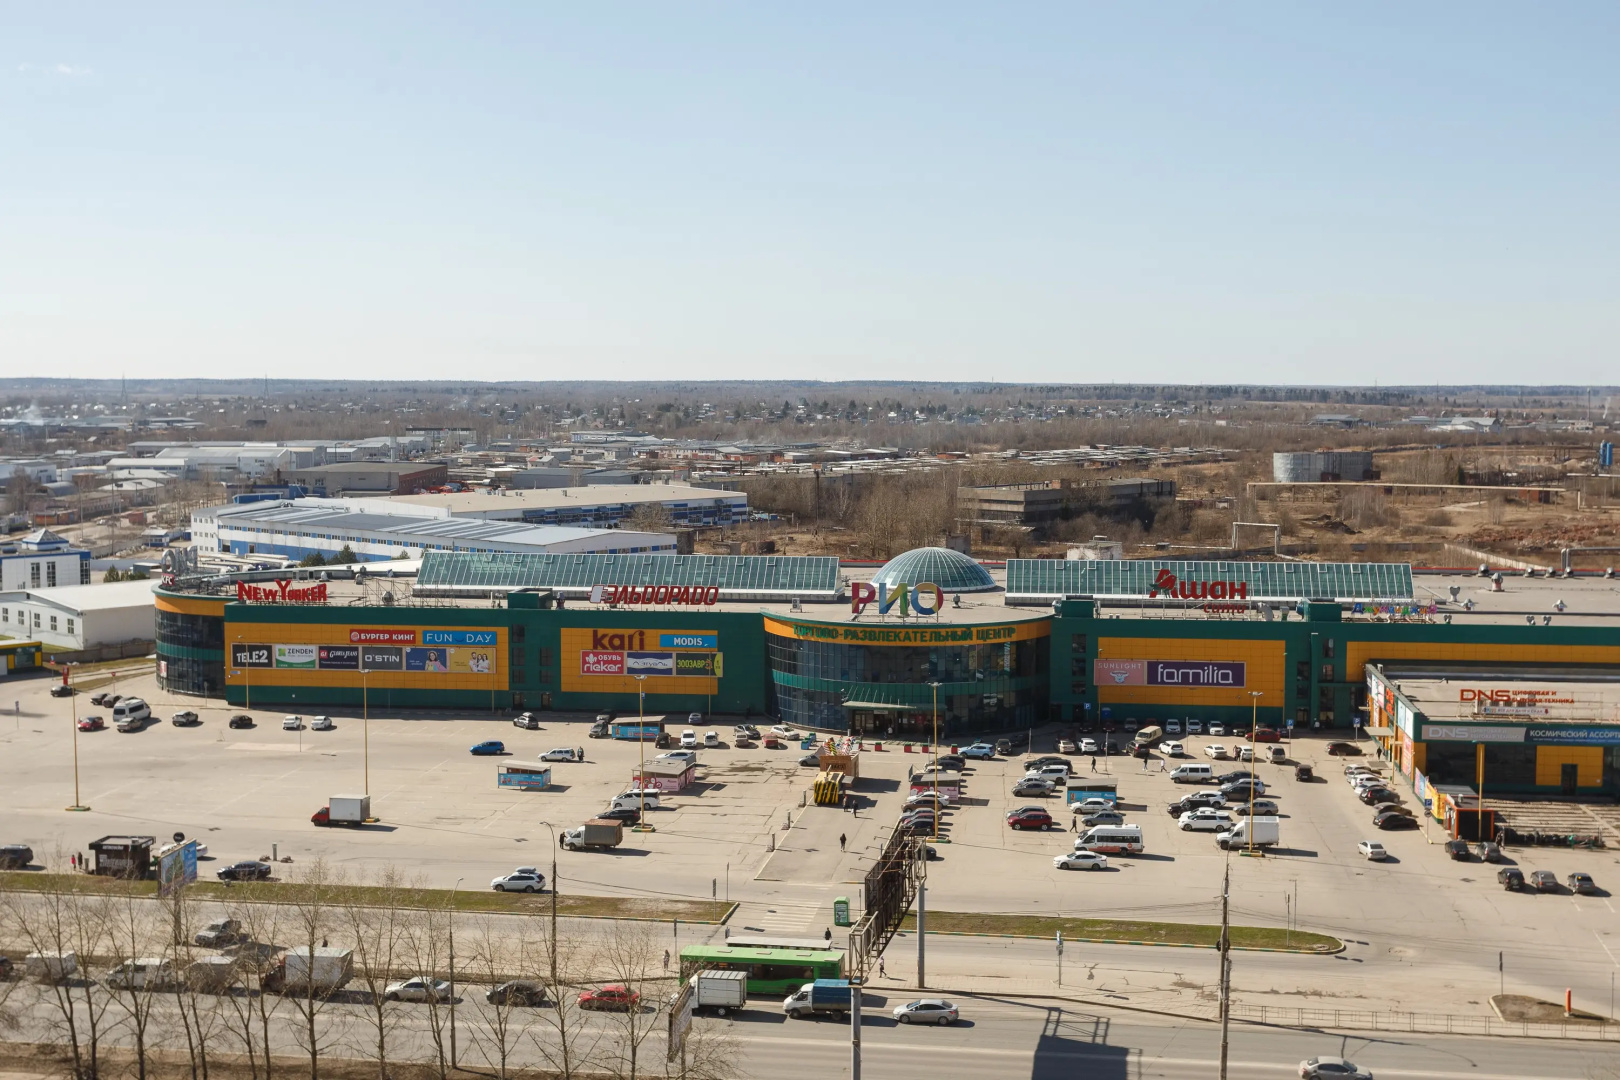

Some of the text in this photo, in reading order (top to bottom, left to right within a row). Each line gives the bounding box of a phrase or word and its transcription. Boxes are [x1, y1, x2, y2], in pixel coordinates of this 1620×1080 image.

[161, 574, 173, 585] KFC
[1149, 569, 1247, 600] Ашан
[851, 581, 944, 616] РИО
[392, 633, 415, 641] КИНГ
[426, 633, 492, 643] FUN DAY
[592, 629, 645, 651] kari
[976, 627, 1016, 642] ЦЕНТР
[673, 637, 703, 646] MODIS
[236, 650, 269, 663] TELE2
[583, 661, 622, 672] rieker
[1097, 662, 1142, 670] SUNLIGHT
[1157, 664, 1234, 684] familia
[1460, 689, 1511, 702] DNS
[1428, 727, 1469, 738] DNS
[1529, 729, 1588, 738] КОСМИЧЕСКИЙ
